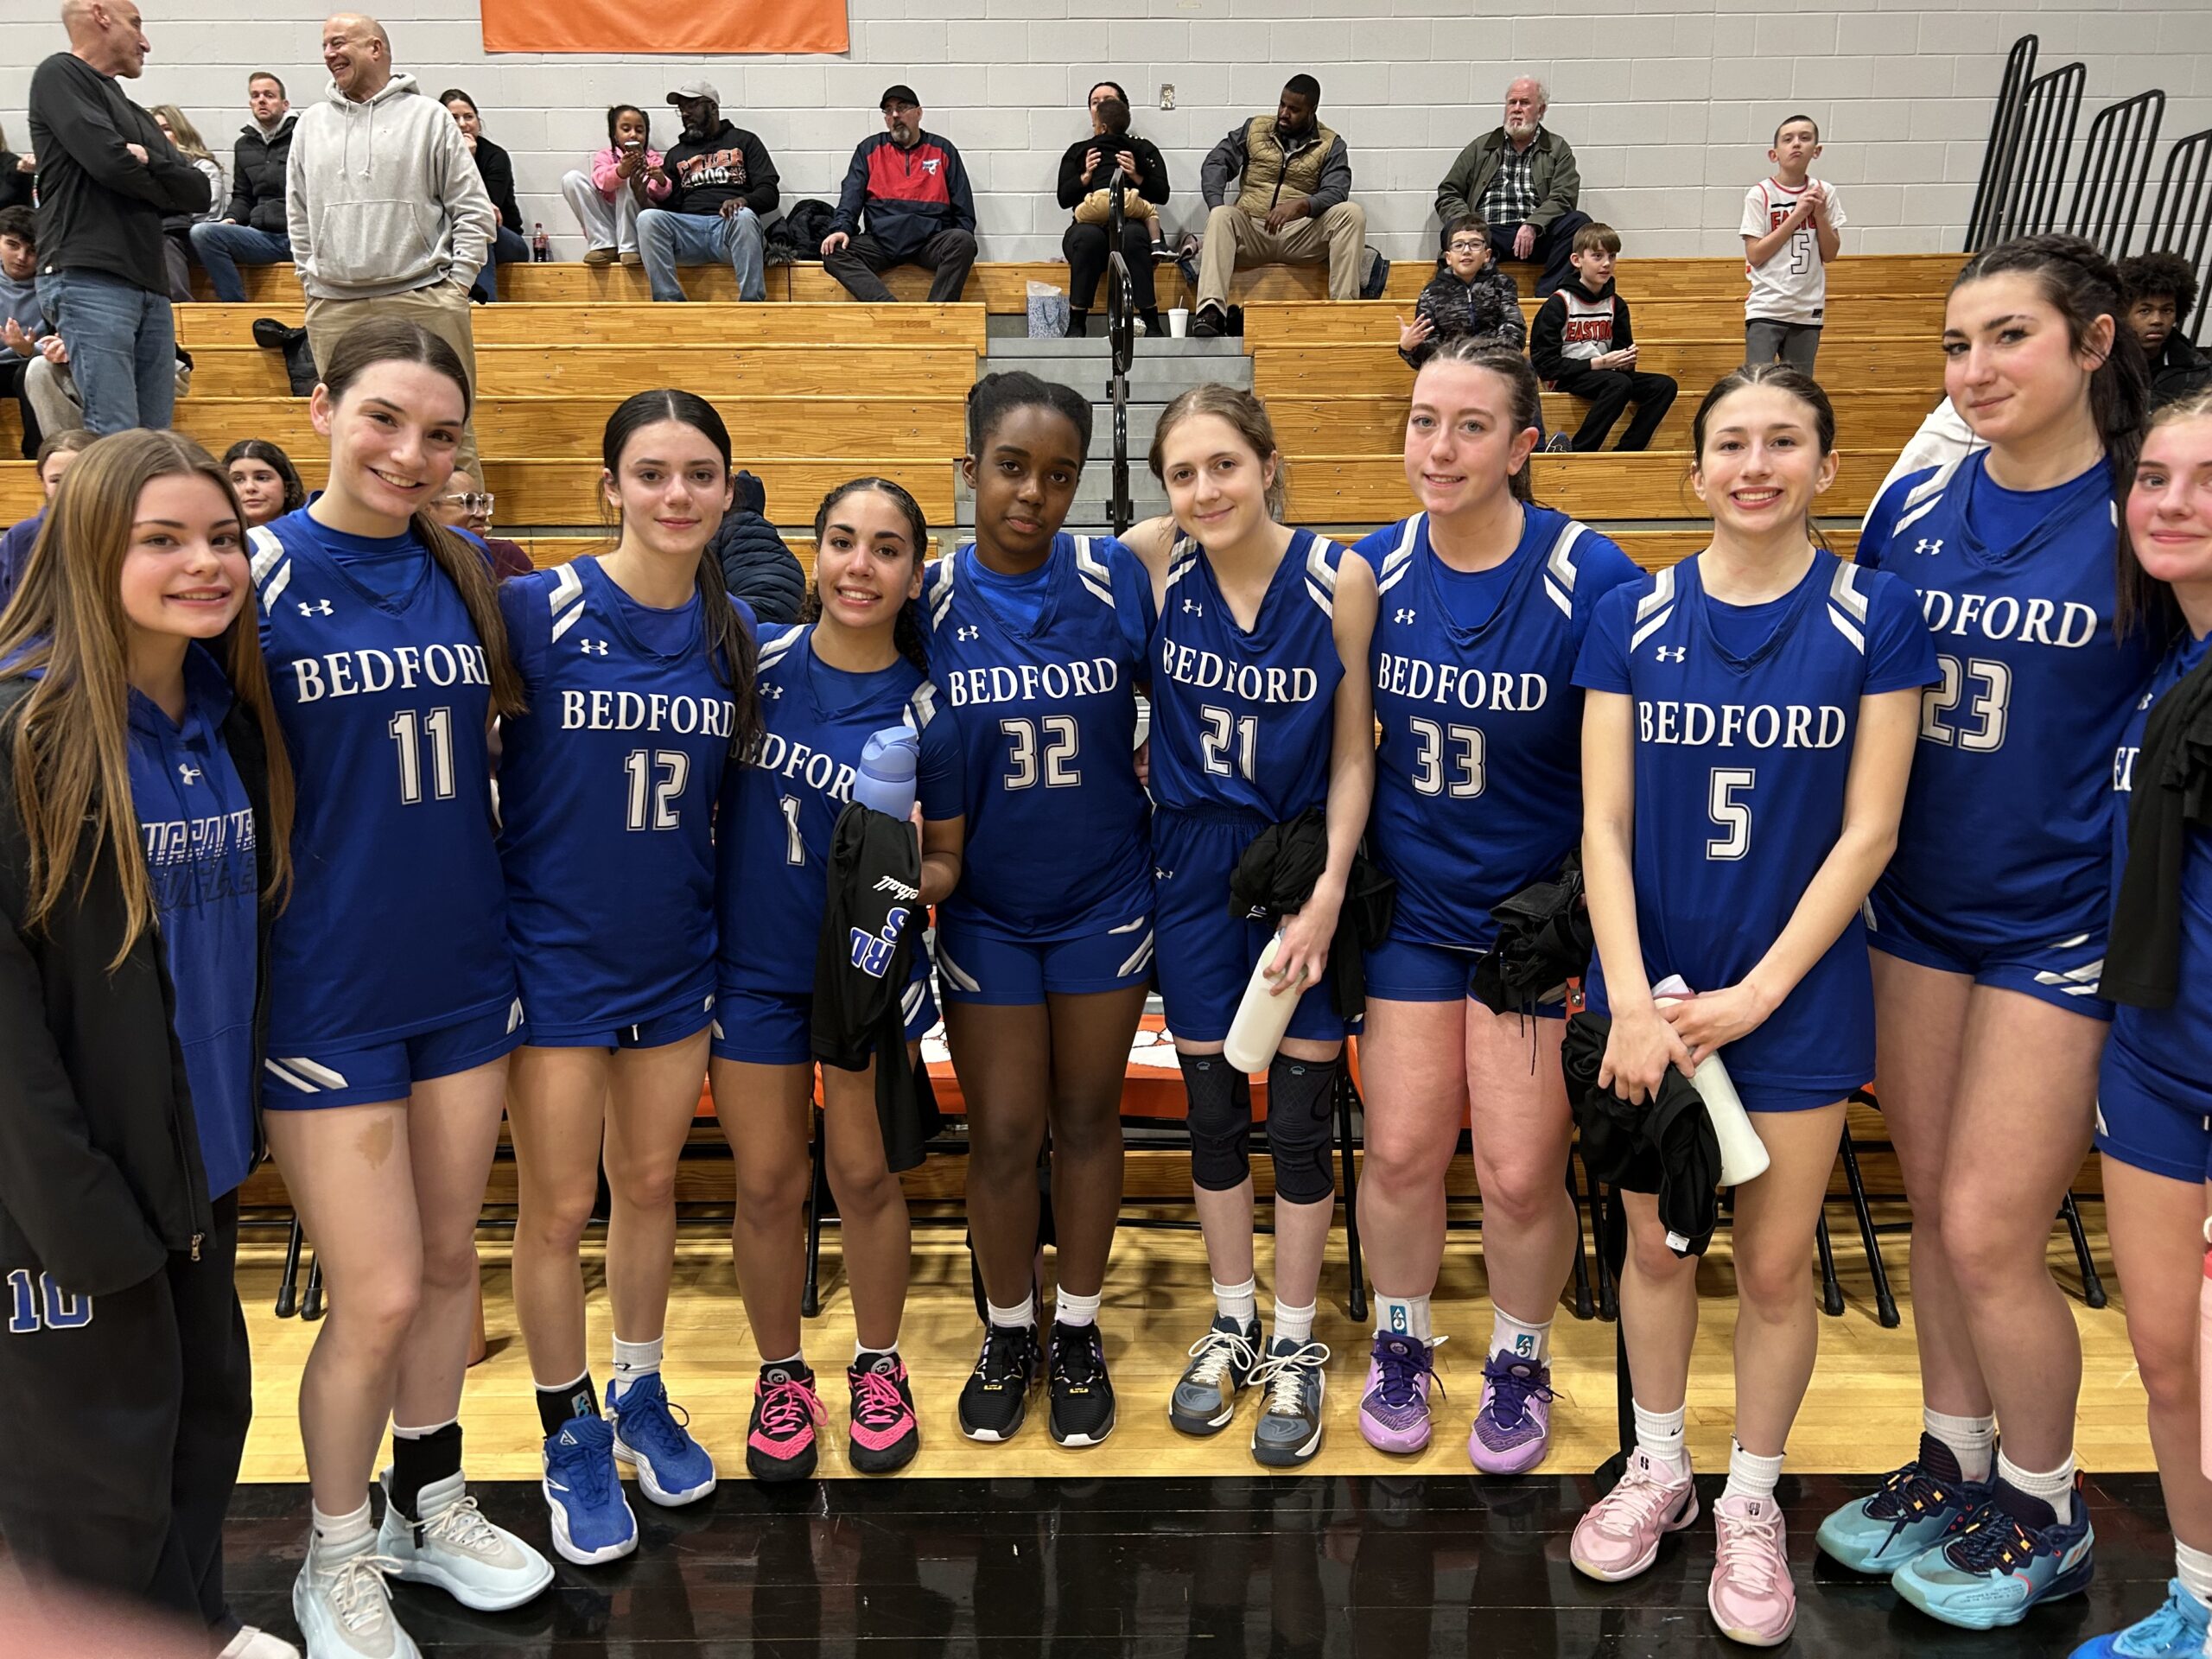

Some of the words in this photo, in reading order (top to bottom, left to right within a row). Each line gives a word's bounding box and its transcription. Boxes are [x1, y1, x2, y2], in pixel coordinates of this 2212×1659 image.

[1790, 232, 1810, 275] 5
[1915, 589, 2098, 648] DFORD
[949, 657, 1118, 707] BEDFORD
[1162, 637, 1318, 703] BEDFORD
[1377, 652, 1548, 711] BEDFORD
[1919, 653, 2012, 753] 23
[562, 690, 736, 738] BEDFORD
[1199, 703, 1258, 784] 21
[1638, 701, 1846, 748] BEDFORD
[389, 706, 456, 805] 11
[624, 749, 690, 831] 12
[999, 715, 1081, 791] 32
[1409, 715, 1486, 799] 33
[779, 793, 805, 867] 1
[1706, 767, 1756, 861] 5
